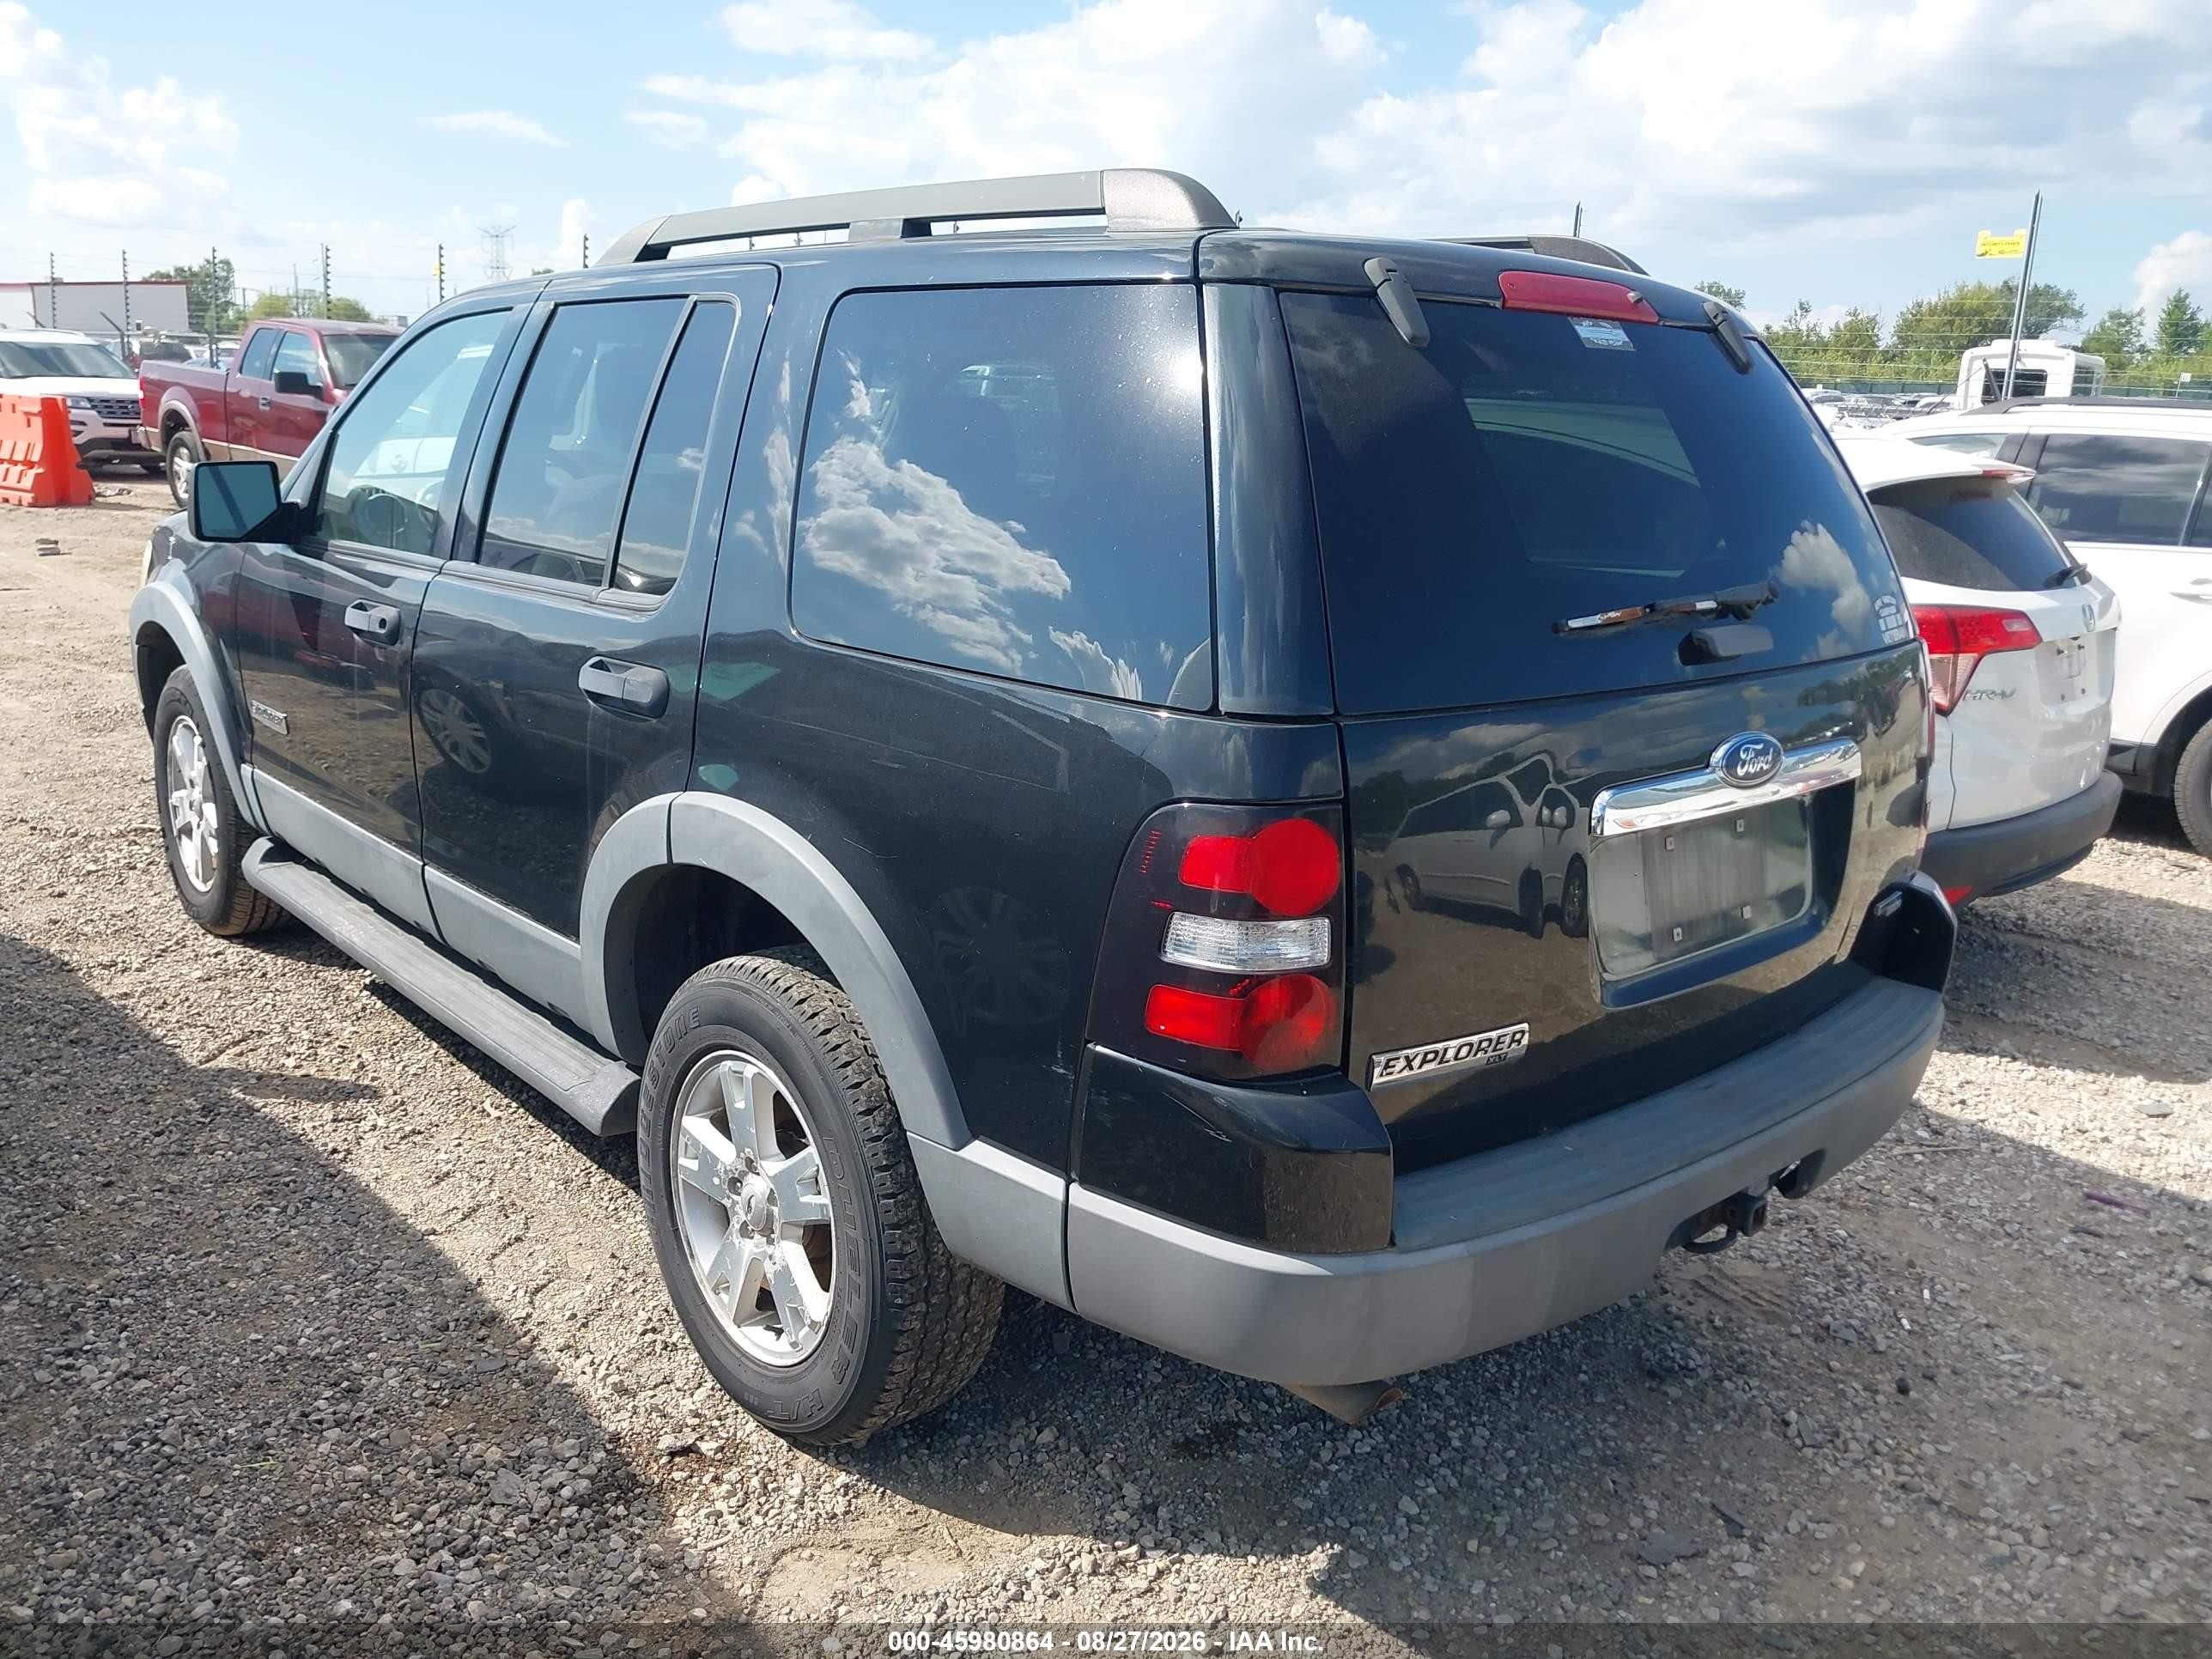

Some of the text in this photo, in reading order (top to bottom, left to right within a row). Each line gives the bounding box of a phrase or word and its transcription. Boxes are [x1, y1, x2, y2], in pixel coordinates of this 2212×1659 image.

[1736, 743, 1773, 776] Ford
[1380, 1030, 1526, 1078] EXPLORER
[1487, 1054, 1507, 1065] XLT
[766, 1136, 860, 1422] DUELER H/T
